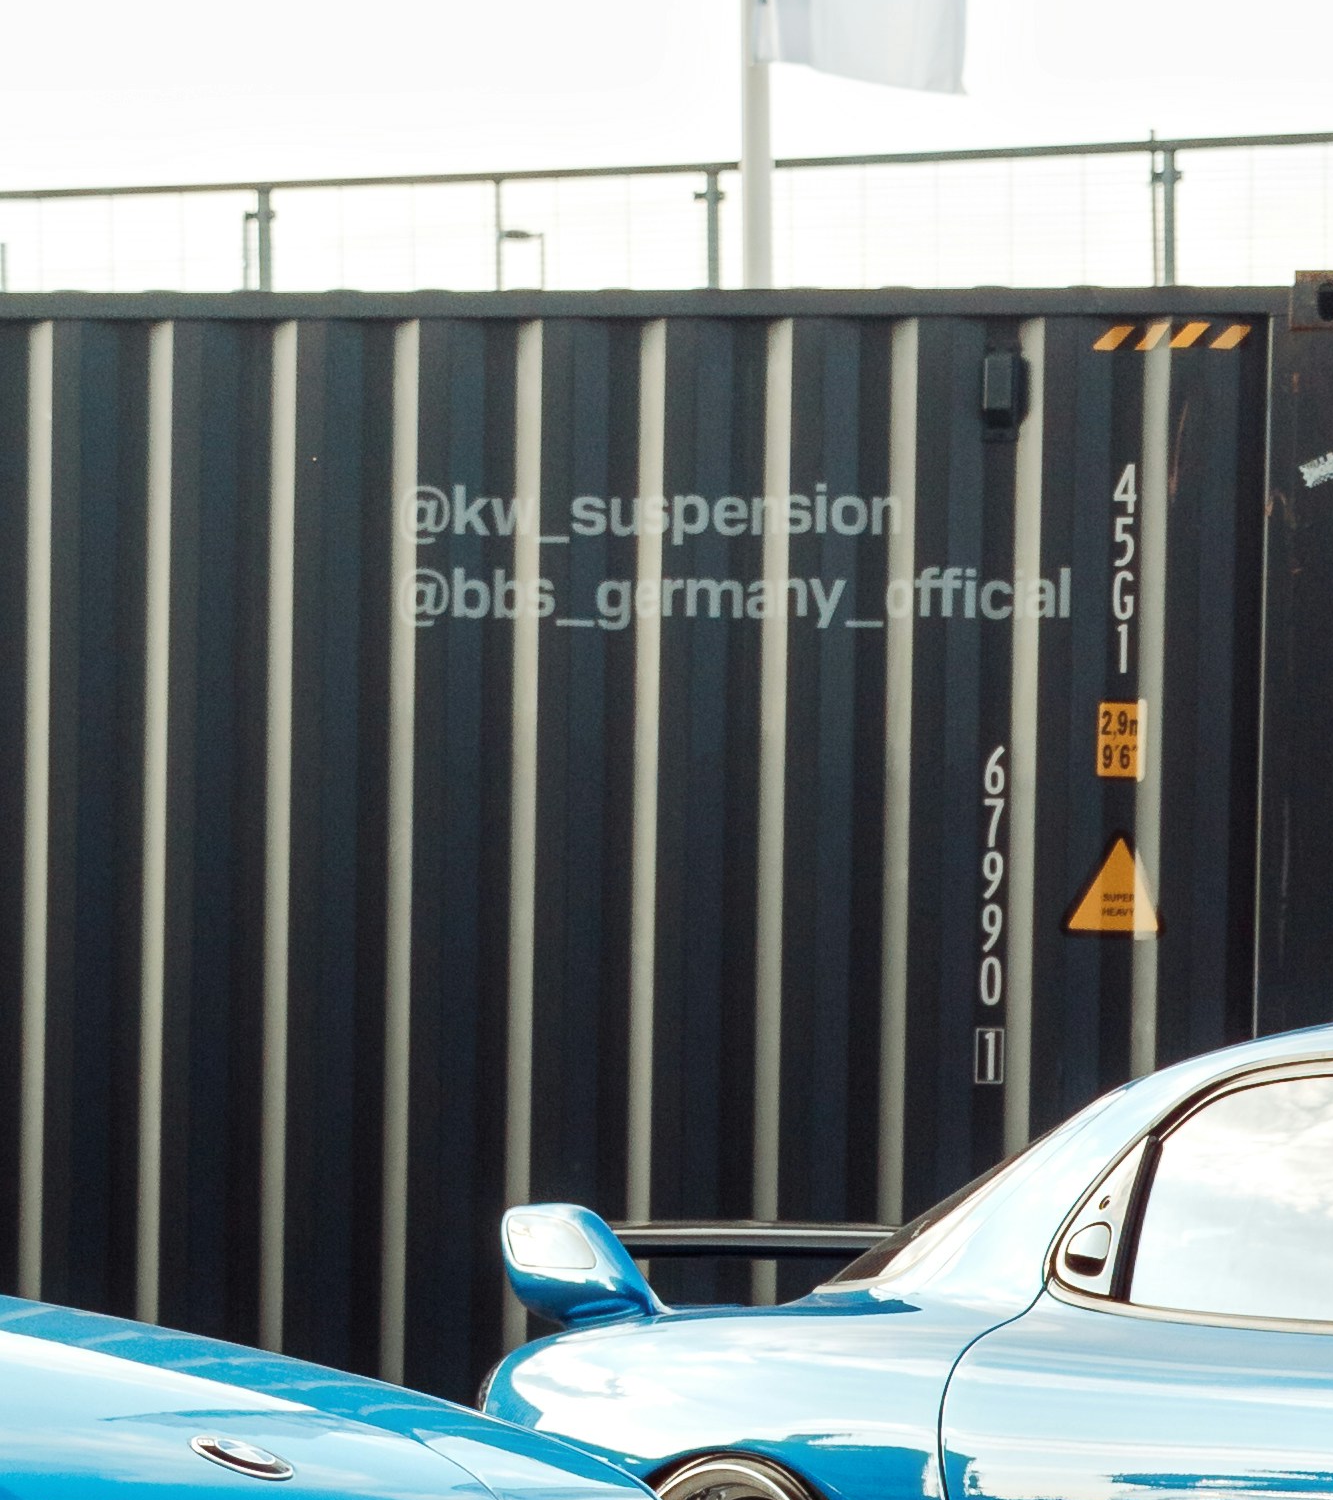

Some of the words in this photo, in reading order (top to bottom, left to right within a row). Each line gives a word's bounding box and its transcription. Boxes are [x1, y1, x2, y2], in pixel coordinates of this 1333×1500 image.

[399, 482, 903, 546] @kw_suspension
[399, 566, 1072, 631] @bbs_germany_official
[1112, 463, 1138, 675] 45G1
